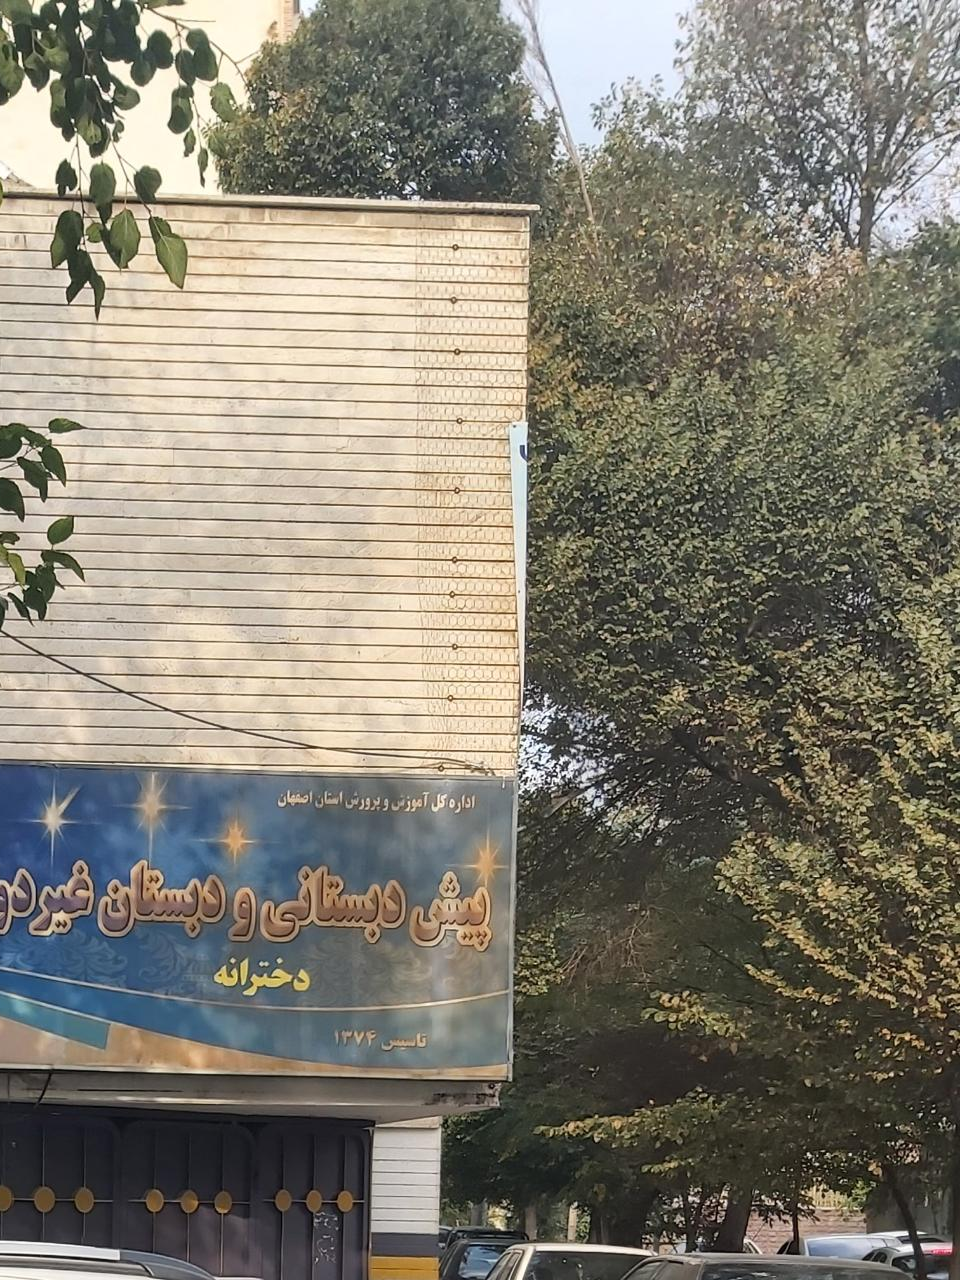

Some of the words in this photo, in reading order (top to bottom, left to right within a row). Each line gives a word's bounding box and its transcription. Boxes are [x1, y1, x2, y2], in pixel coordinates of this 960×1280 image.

[277, 790, 313, 808] اصفهان
[315, 791, 343, 809] استان
[345, 792, 382, 811] پرورش
[383, 797, 390, 811] و
[391, 791, 430, 812] آموزش
[431, 793, 449, 812] کل
[449, 794, 476, 813] اداره
[97, 859, 226, 938] دبستان
[259, 864, 407, 944] دبستانی
[228, 887, 256, 942] و
[409, 871, 492, 952] پیش
[213, 956, 311, 996] دخترانه
[334, 1029, 377, 1048] ۱۳۷۴
[381, 1032, 428, 1052] تاسیس
